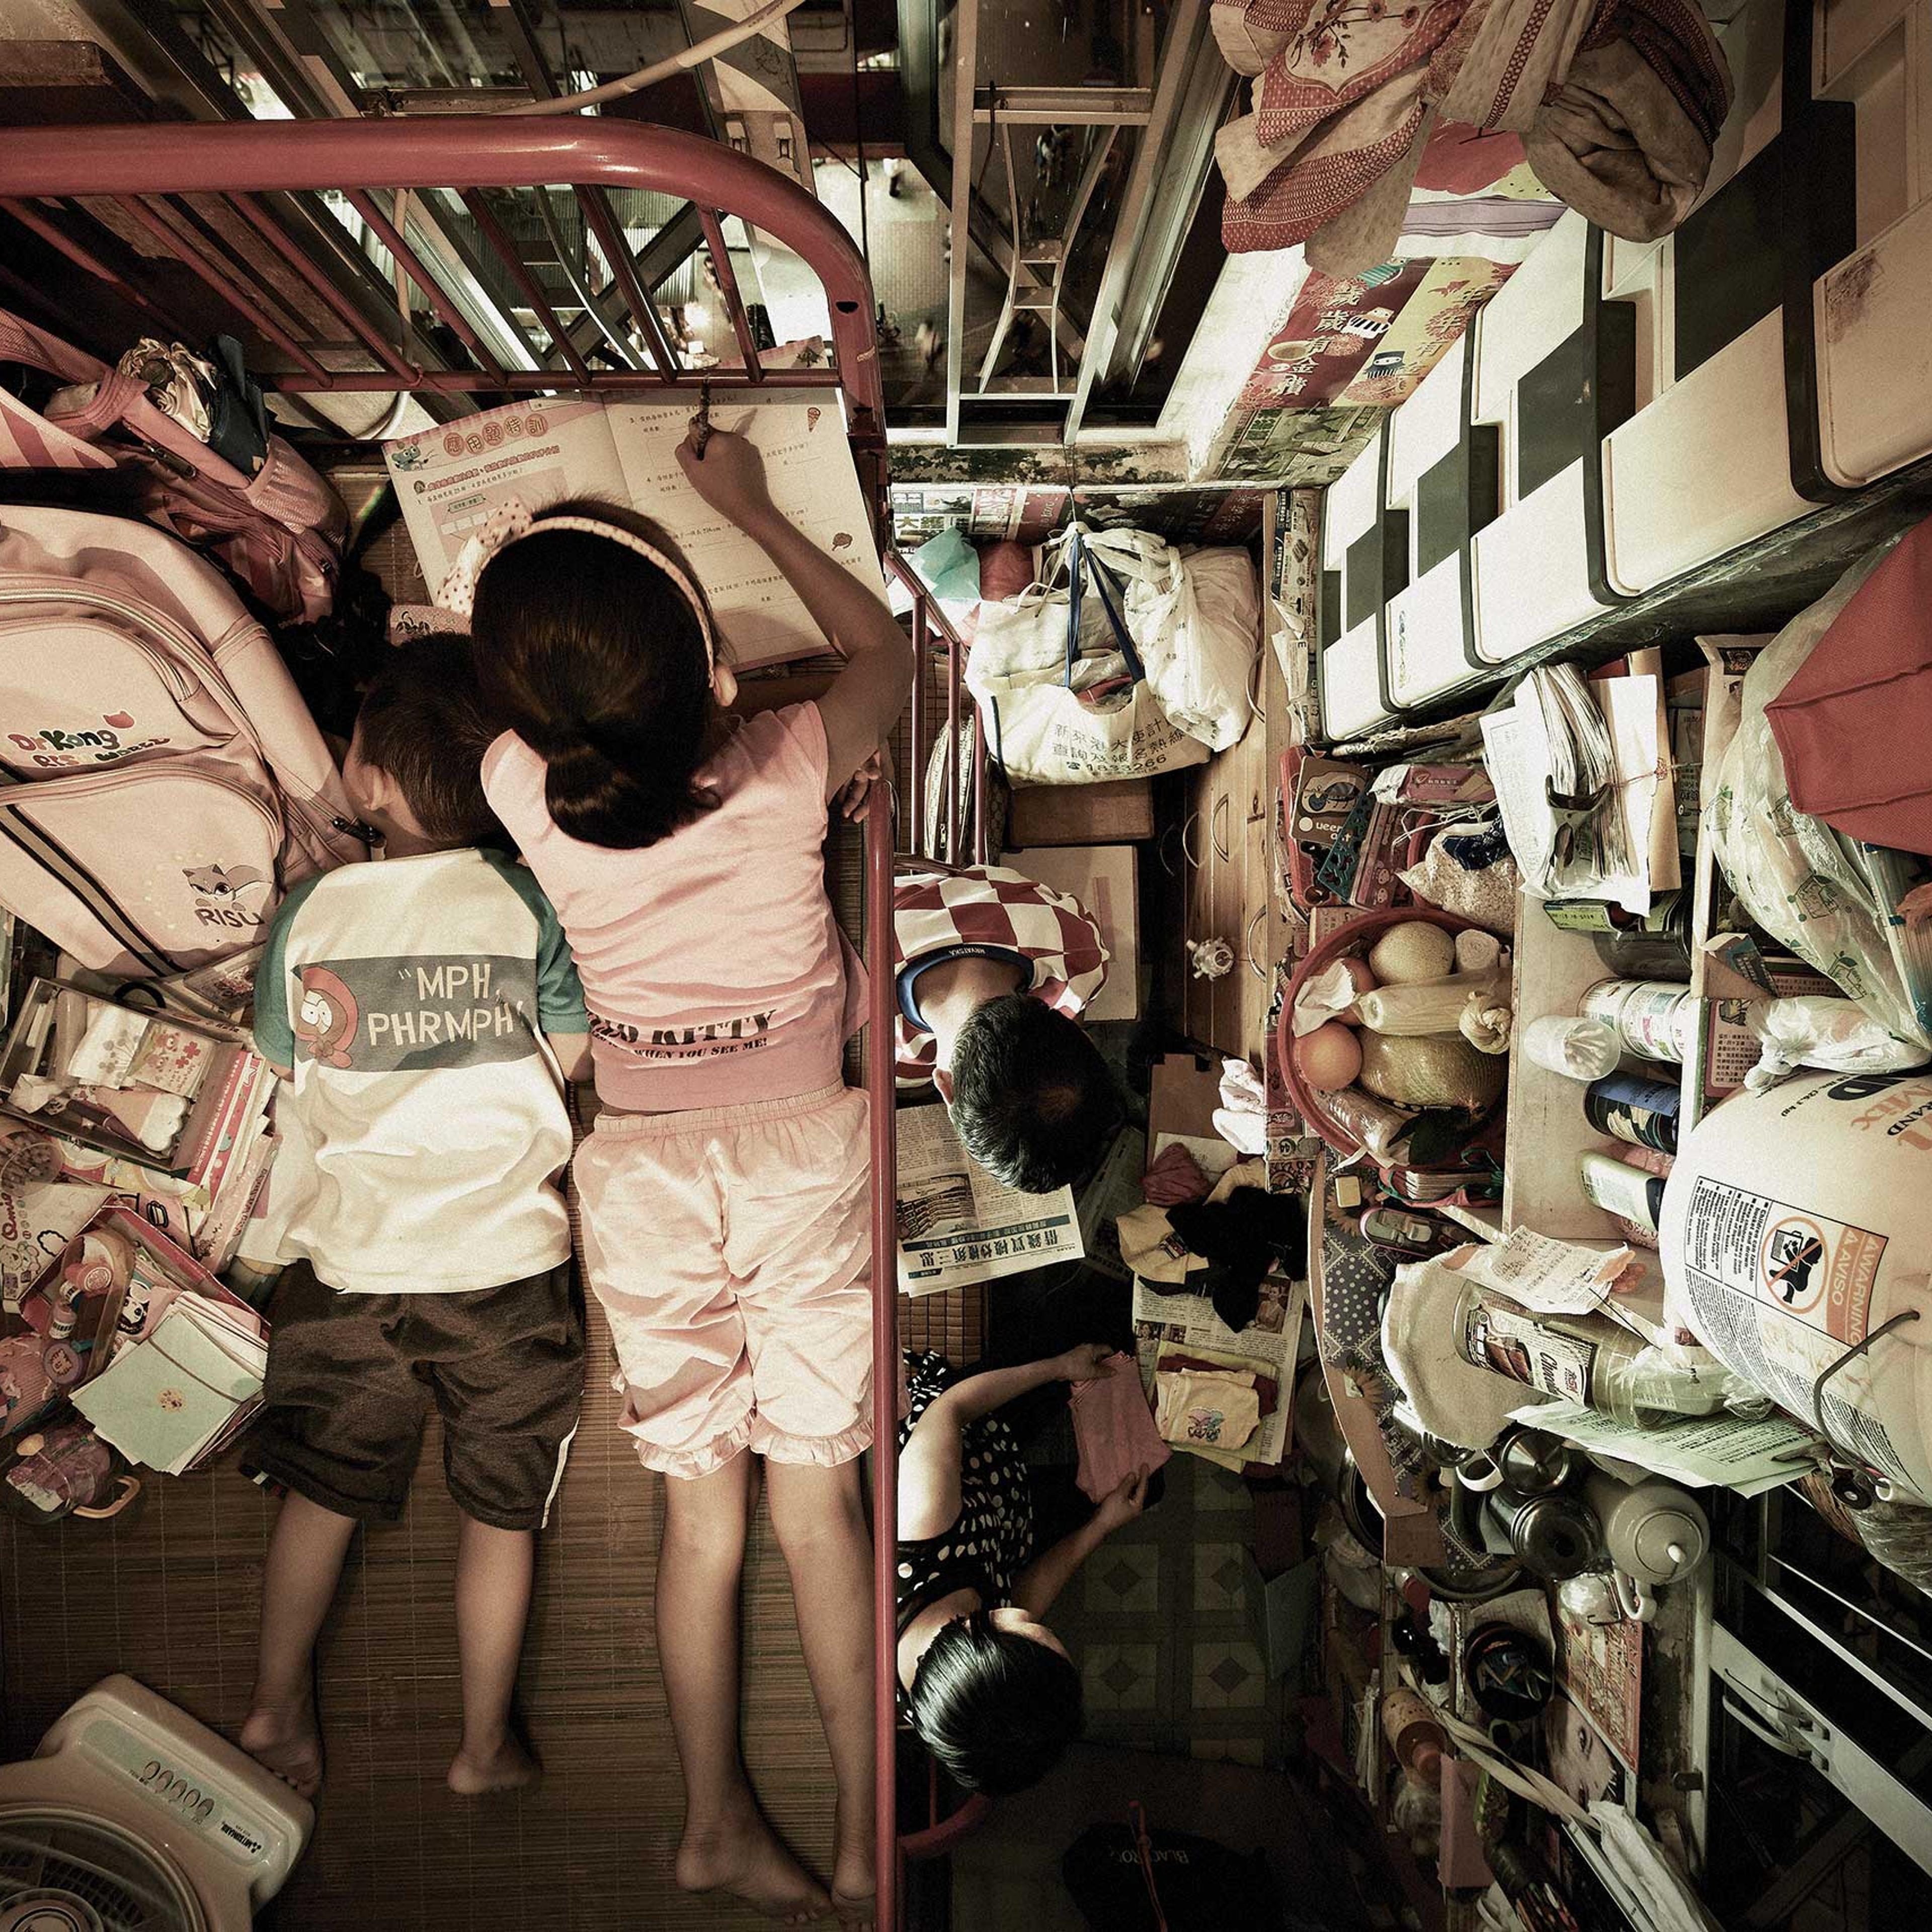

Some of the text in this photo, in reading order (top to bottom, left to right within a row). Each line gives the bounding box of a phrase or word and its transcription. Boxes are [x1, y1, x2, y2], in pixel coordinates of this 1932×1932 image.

[195, 908, 265, 928] RISU
[679, 1048, 707, 1059] YOU
[711, 1043, 738, 1056] SEE
[1831, 1248, 1852, 1306] AVISO
[1848, 1254, 1875, 1345] WARNING
